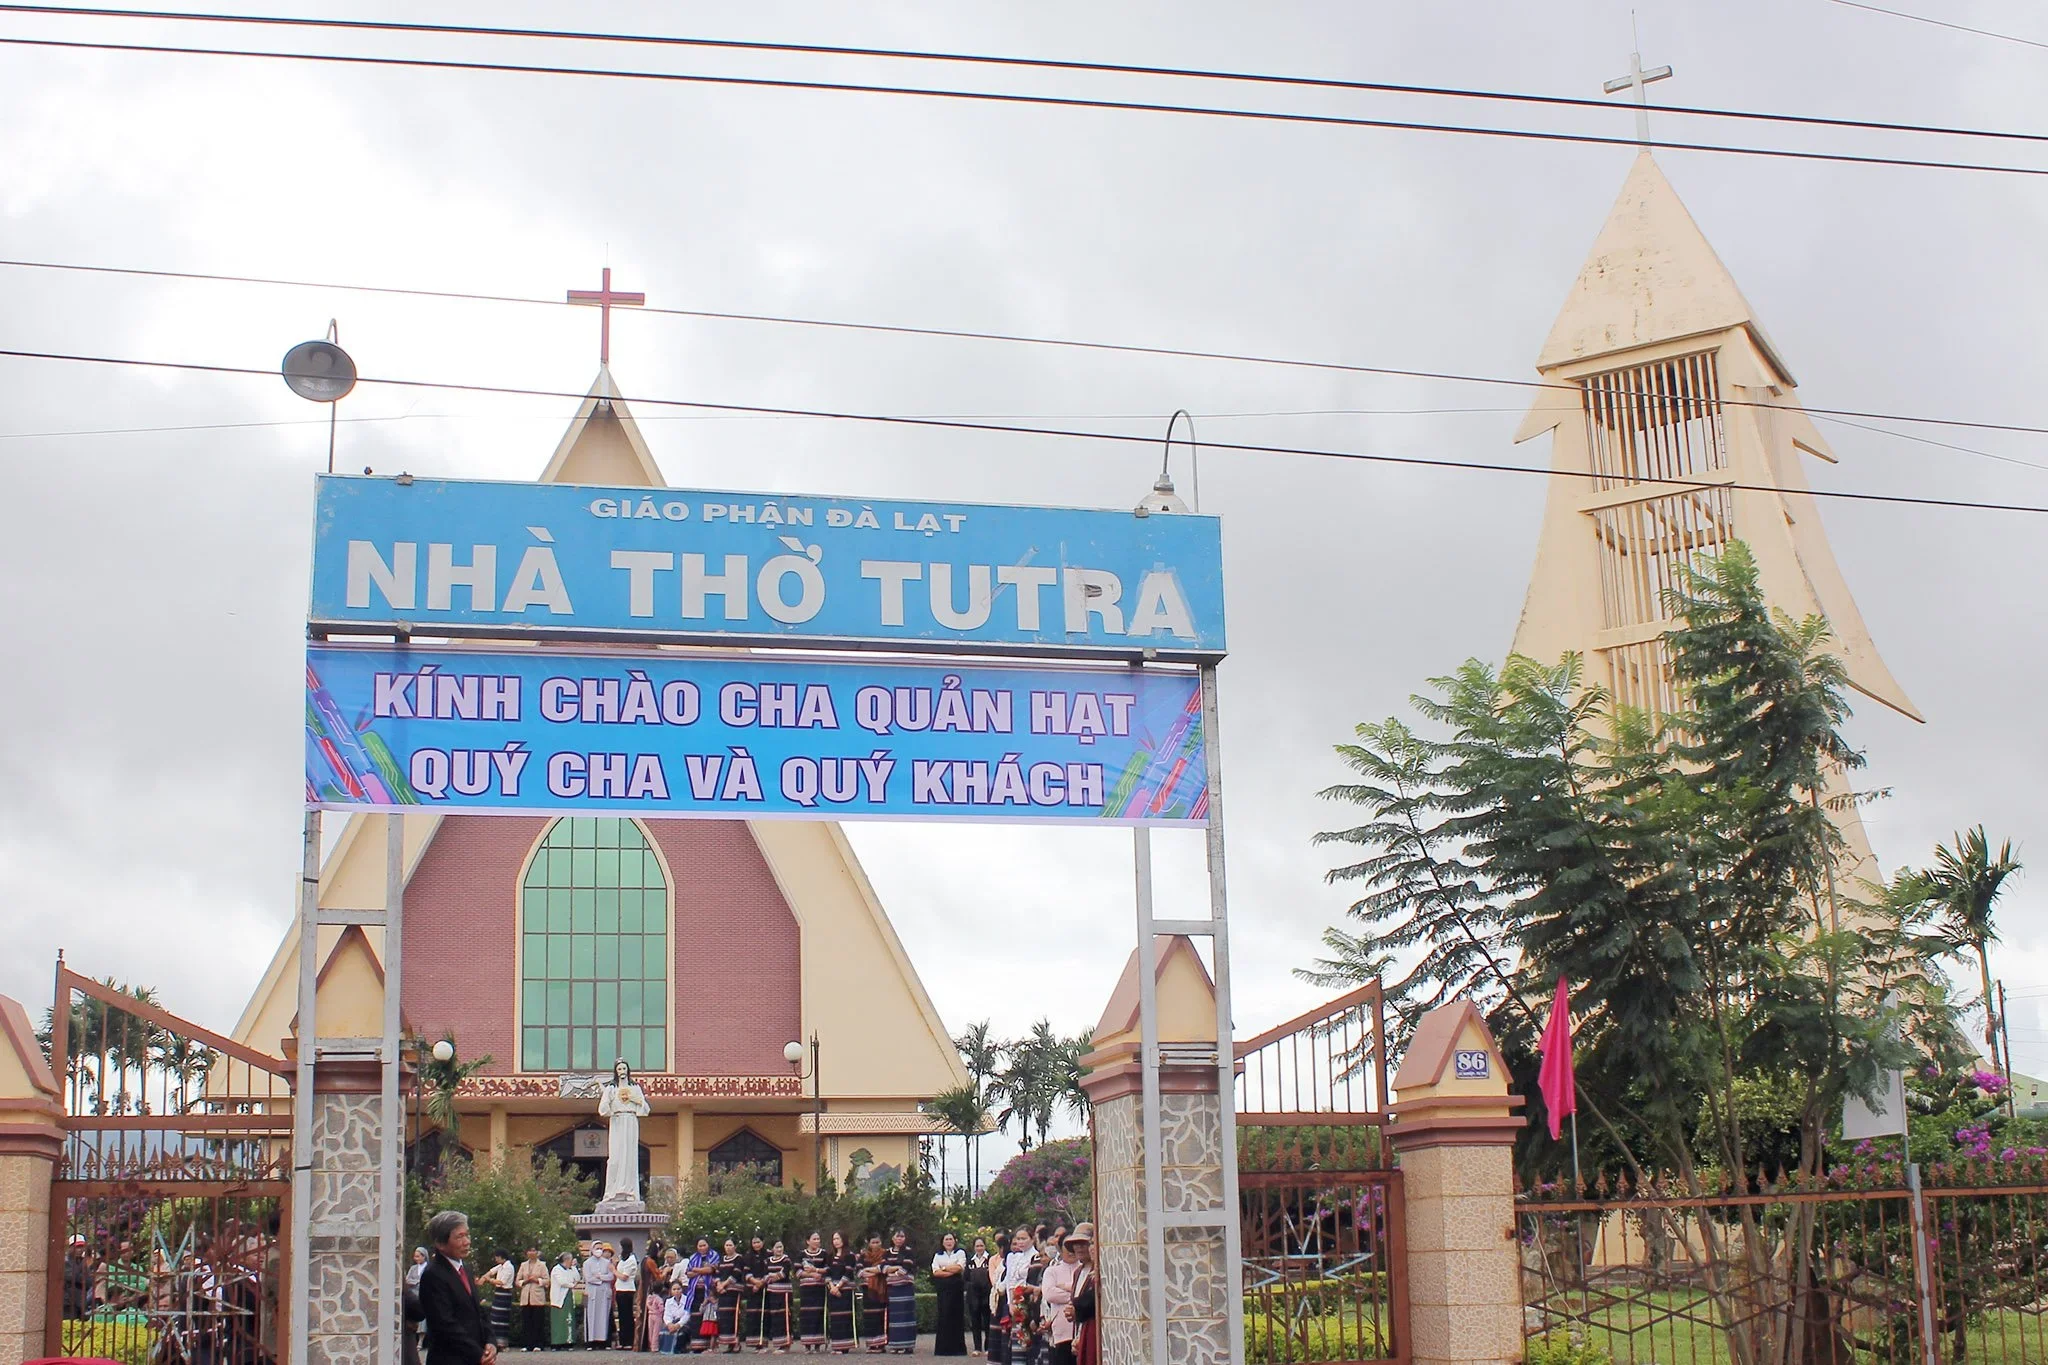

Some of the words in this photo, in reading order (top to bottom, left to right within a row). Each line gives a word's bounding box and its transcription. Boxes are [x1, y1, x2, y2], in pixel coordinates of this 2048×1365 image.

[589, 496, 691, 522] GIÁO
[703, 502, 814, 529] PHẬN
[825, 505, 881, 529] ĐÀ
[894, 511, 967, 537] LẠT
[346, 527, 575, 616] NHÀ
[610, 536, 826, 624] THỜ
[860, 559, 1198, 638] TUTRA
[373, 664, 522, 722] KÍNH
[540, 669, 701, 726] CHÀO
[719, 682, 840, 730] CHA
[855, 674, 1014, 736] QUẢN
[1030, 691, 1137, 745] HẠT
[409, 741, 531, 801] QUÝ
[547, 751, 671, 800] CHA
[684, 745, 766, 801] VÀ
[780, 749, 897, 808] QUÝ
[912, 752, 1105, 807] KHÁCH
[1457, 1052, 1486, 1070] 86
